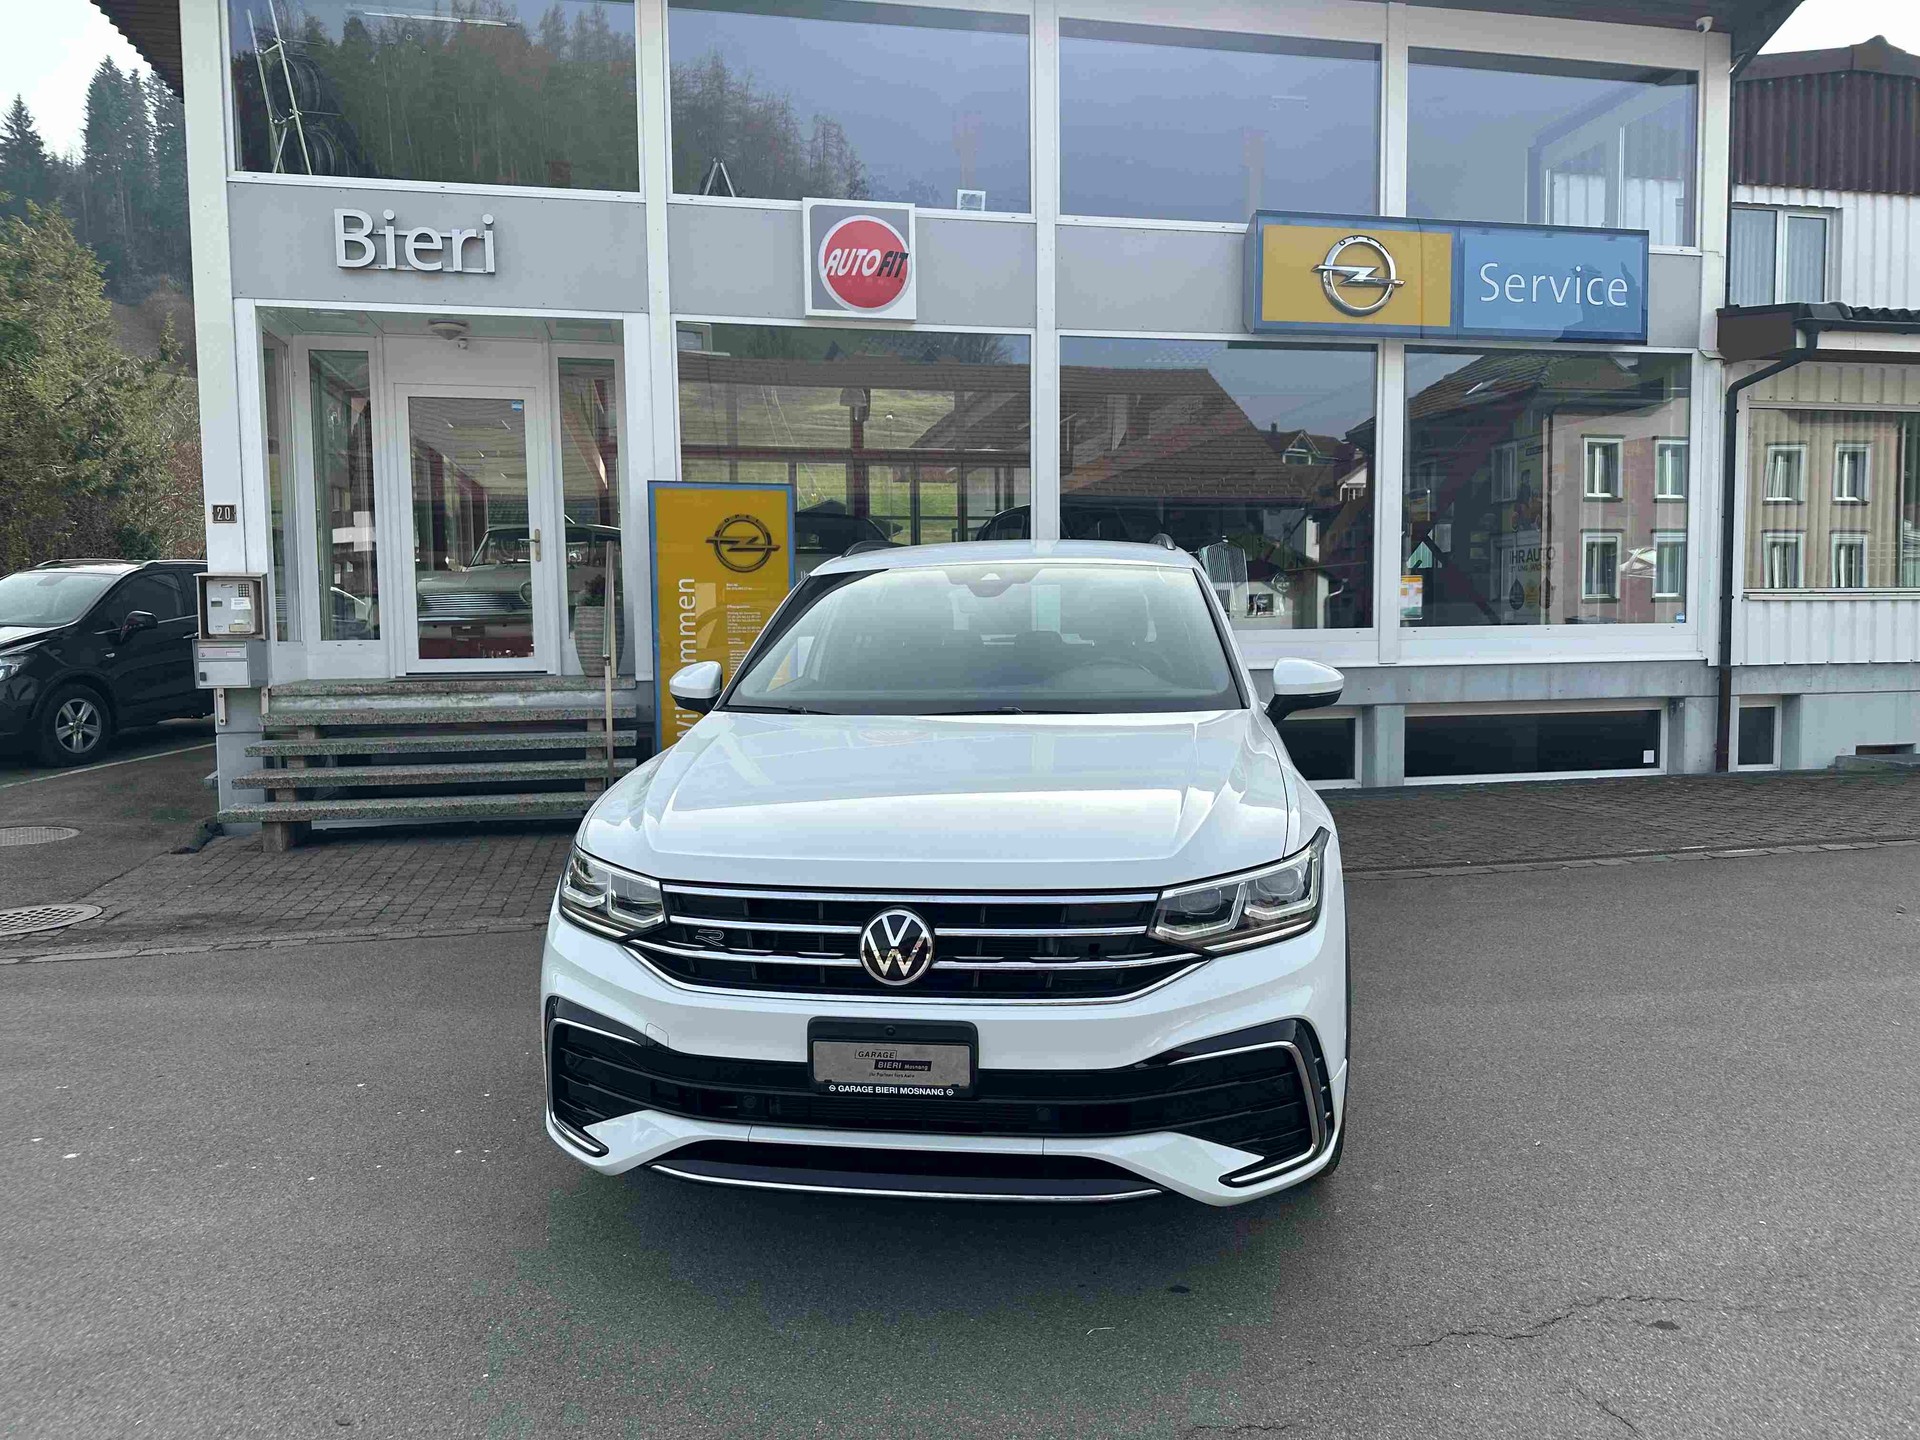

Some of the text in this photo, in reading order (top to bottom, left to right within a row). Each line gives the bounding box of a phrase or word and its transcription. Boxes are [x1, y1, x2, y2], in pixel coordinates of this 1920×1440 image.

[334, 208, 495, 274] Bieri
[1478, 261, 1629, 307] Service
[216, 506, 231, 521] 20
[864, 910, 929, 977] VW
[857, 1051, 895, 1059] GARAGE
[877, 1061, 902, 1069] BIERI
[837, 1085, 944, 1096] GARAGE BIERI MOSNANG
